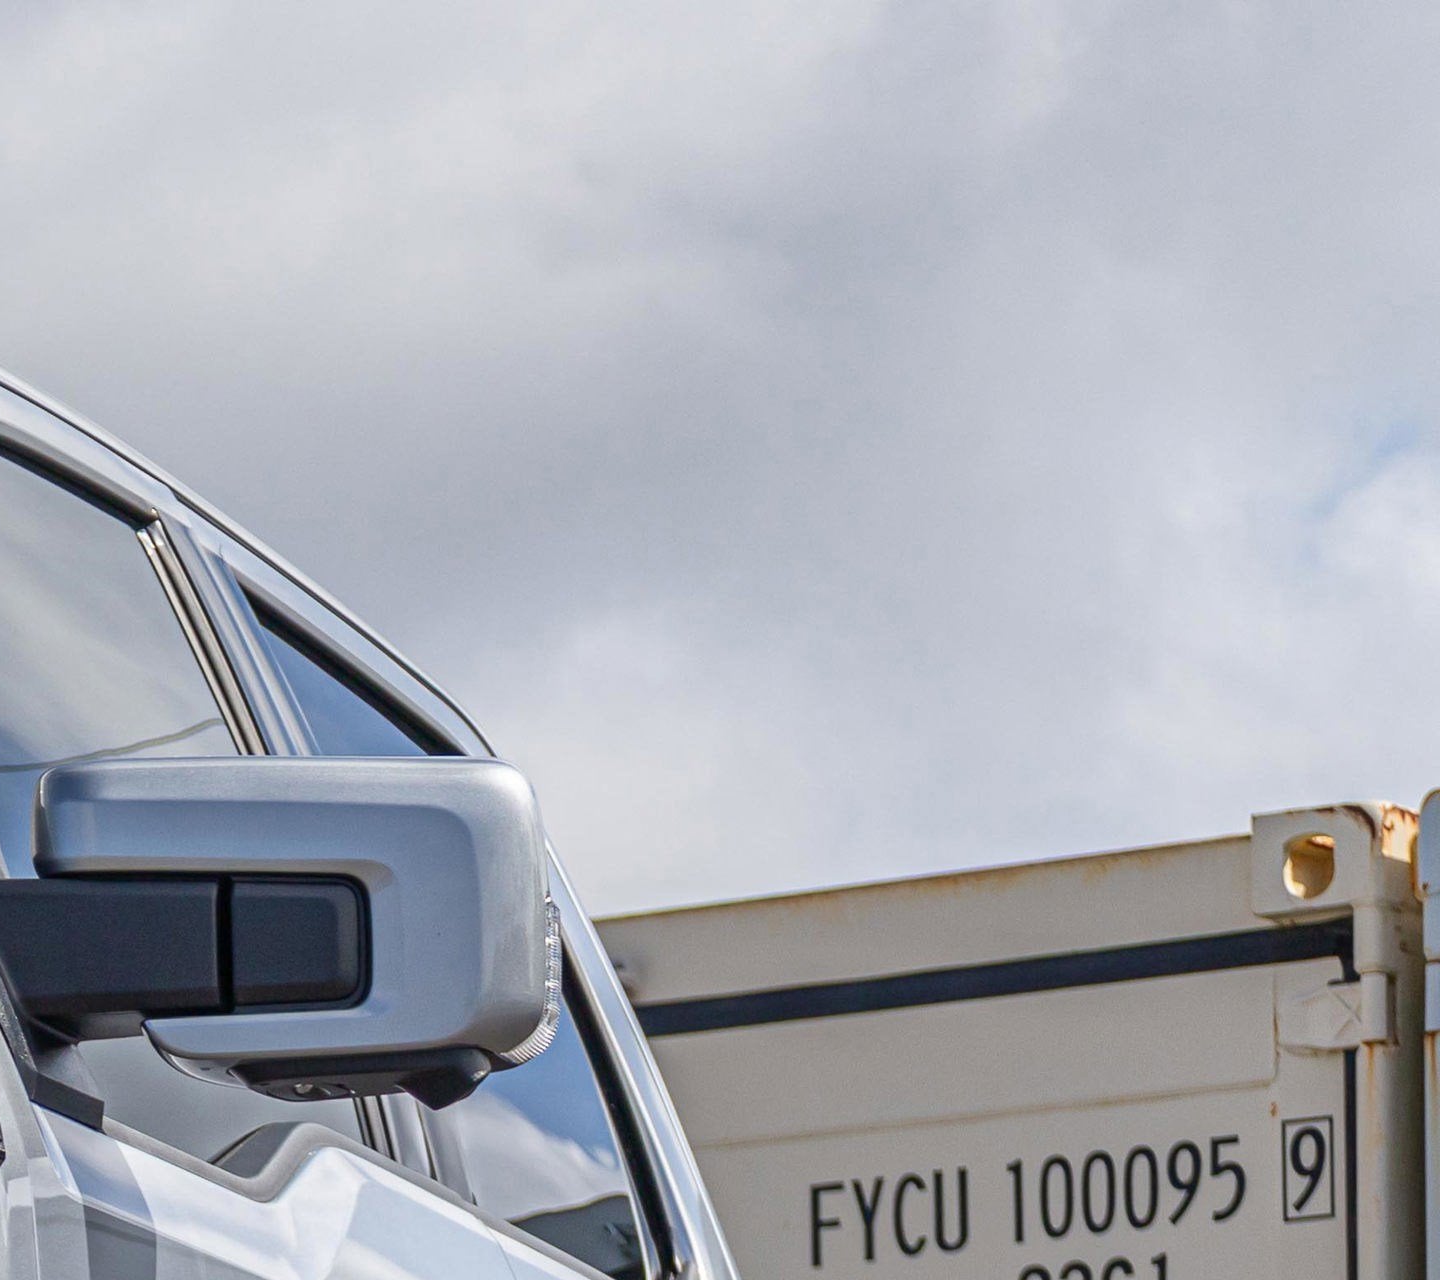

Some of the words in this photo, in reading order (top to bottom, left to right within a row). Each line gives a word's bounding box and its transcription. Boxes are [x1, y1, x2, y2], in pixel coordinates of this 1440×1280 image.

[810, 1166, 970, 1268] FYCU
[1006, 1134, 1247, 1244] 100095
[1290, 1125, 1327, 1213] 9
